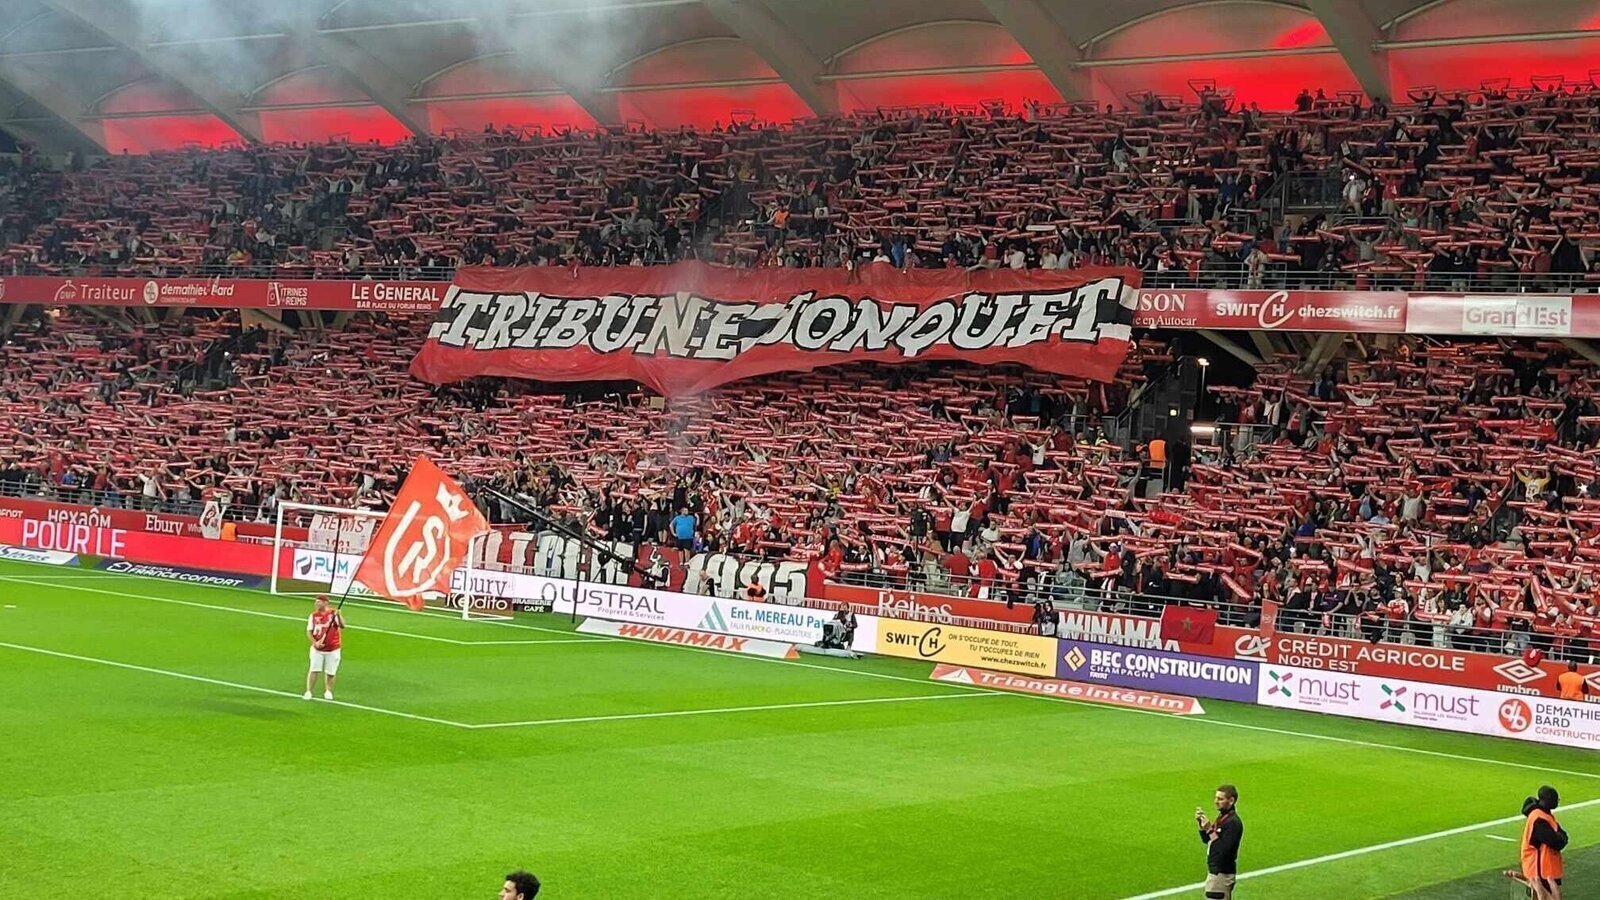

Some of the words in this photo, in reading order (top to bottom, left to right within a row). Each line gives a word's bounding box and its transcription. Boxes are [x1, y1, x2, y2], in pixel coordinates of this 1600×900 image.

[81, 283, 137, 300] Traiteur
[286, 297, 307, 306] REIMS
[356, 301, 371, 309] BAR
[1139, 293, 1186, 311] SON
[438, 289, 758, 360] TRIBUNE
[744, 276, 1124, 358] JONQUET
[1157, 315, 1197, 326] Autocar
[1298, 305, 1401, 320] chezswitch.fr
[145, 514, 184, 536] Ebury
[22, 518, 90, 554] POUR
[96, 526, 127, 558] LE
[314, 556, 349, 575] PUM
[635, 611, 665, 621] Services
[730, 606, 752, 621] Ent.
[755, 609, 804, 627] MEREAU
[878, 591, 952, 624] Reims
[618, 623, 750, 651] WINAMAX
[981, 656, 1047, 669] www.chezswitch.fr
[1014, 649, 1023, 657] DE
[1024, 651, 1040, 659] RIEN
[1278, 638, 1352, 659] CRÉDIT
[1356, 646, 1465, 672] AGRICOLE
[1278, 654, 1323, 669] NORD
[1328, 660, 1358, 672] EST
[1090, 649, 1122, 668] BEC
[1126, 653, 1252, 685] CONSTRUCTION
[1090, 665, 1155, 680] CHAMPAGNE
[979, 672, 1083, 696] Triangle
[1298, 676, 1361, 701] must
[1497, 684, 1540, 696] umbro
[1413, 690, 1480, 717] must
[1535, 715, 1570, 728] BARD
